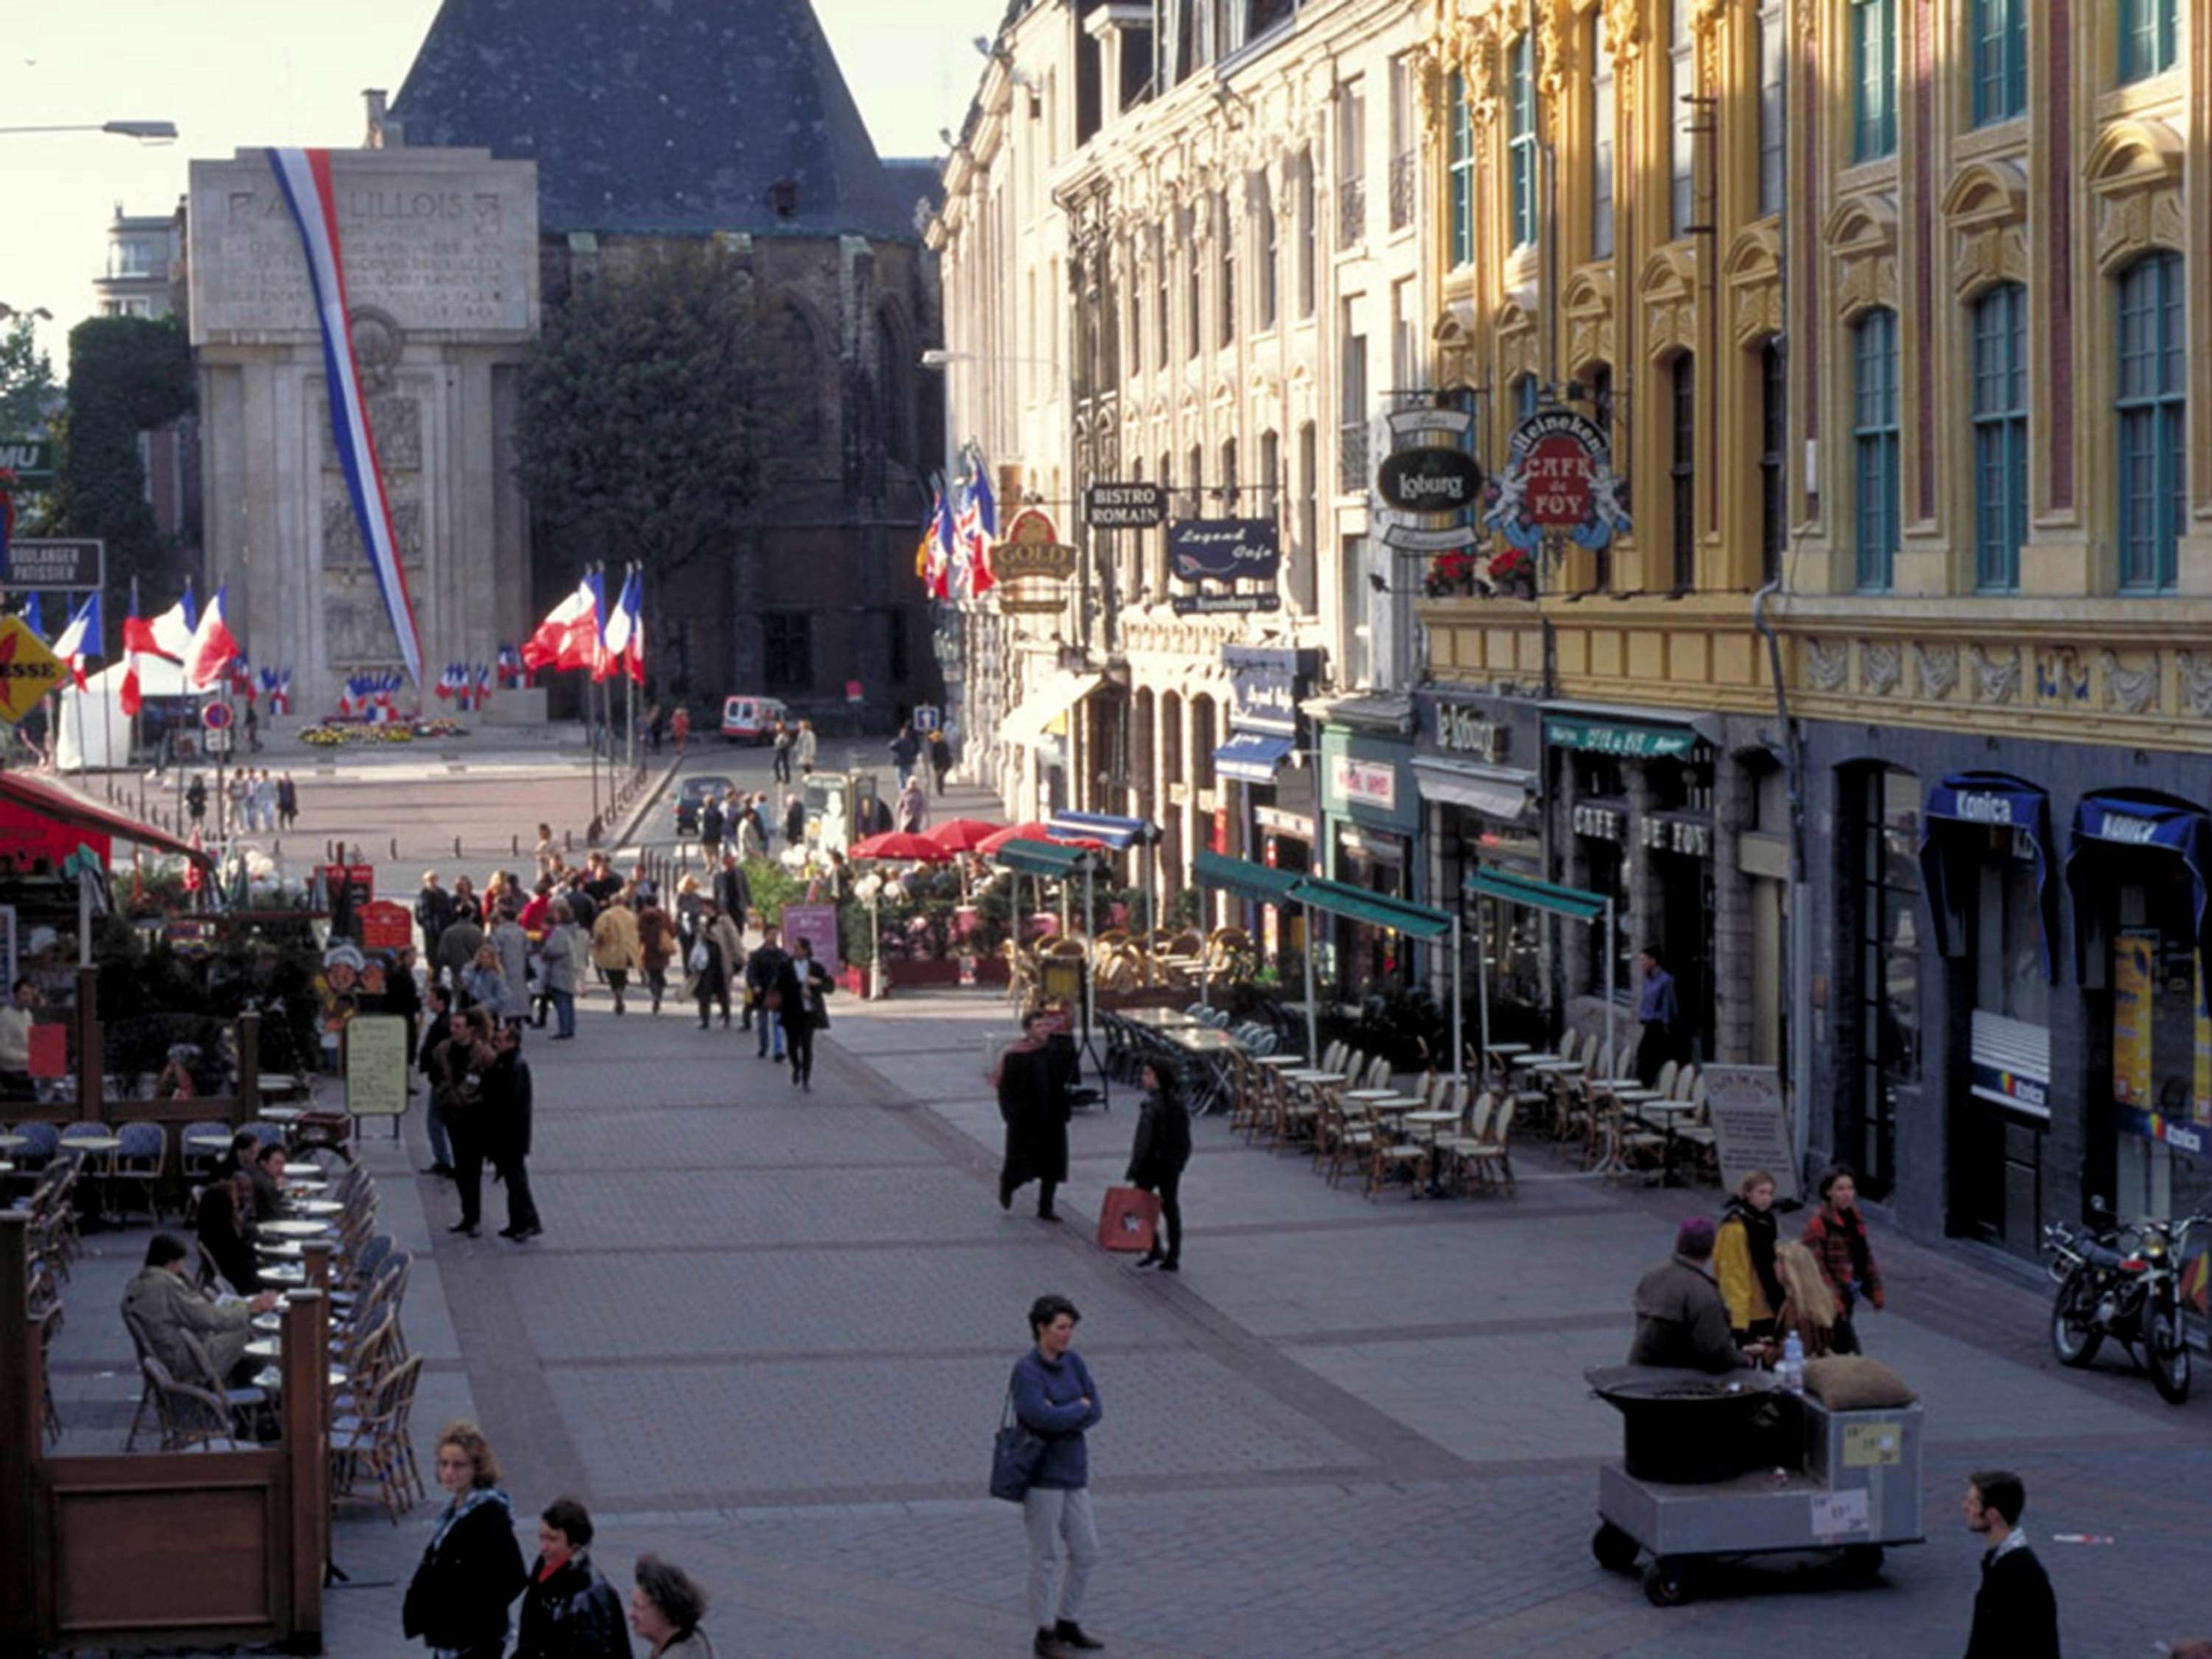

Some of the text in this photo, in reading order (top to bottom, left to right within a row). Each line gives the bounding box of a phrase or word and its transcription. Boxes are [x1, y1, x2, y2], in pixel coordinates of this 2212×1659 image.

[349, 191, 464, 219] LILLOIS
[1513, 415, 1601, 452] Heineken
[1094, 488, 1155, 504] BISTRO
[1535, 495, 1583, 515] FOY
[1091, 508, 1159, 524] ROMAIN
[1177, 528, 1246, 544] Legend
[1956, 790, 2012, 823] Konica
